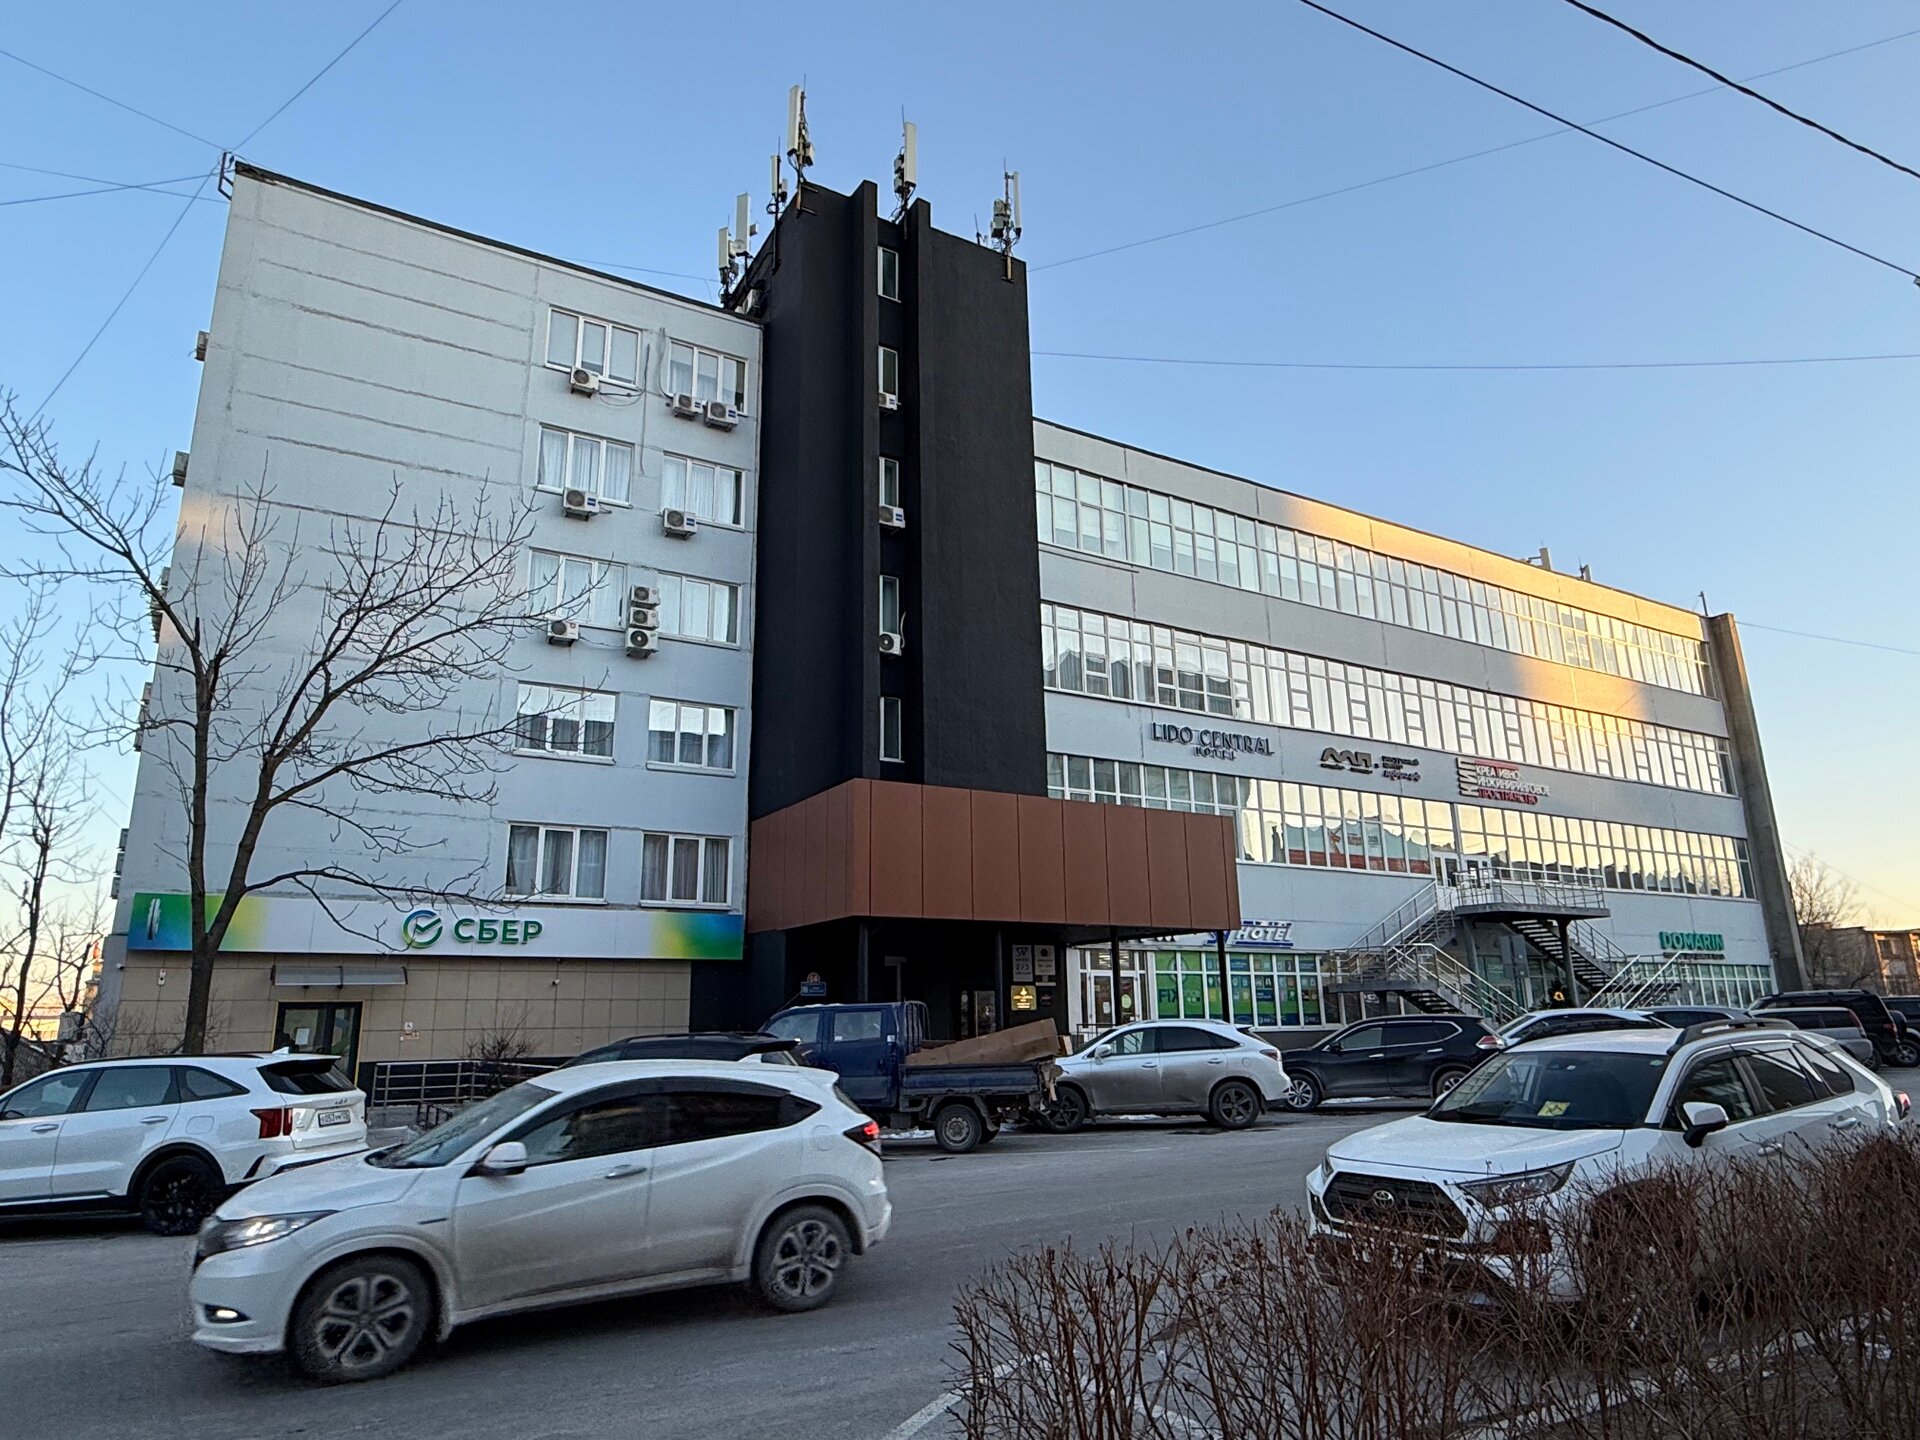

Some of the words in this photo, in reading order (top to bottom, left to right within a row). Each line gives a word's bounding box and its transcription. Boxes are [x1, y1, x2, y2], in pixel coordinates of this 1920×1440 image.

[1152, 722, 1193, 745] LIDO
[1199, 729, 1275, 756] CENTRAL
[1478, 788, 1539, 805] ПРОСТРАНСТВО
[453, 918, 543, 945] СБЕР
[1235, 926, 1294, 943] HOTEL
[1659, 931, 1725, 951] DOMARIN
